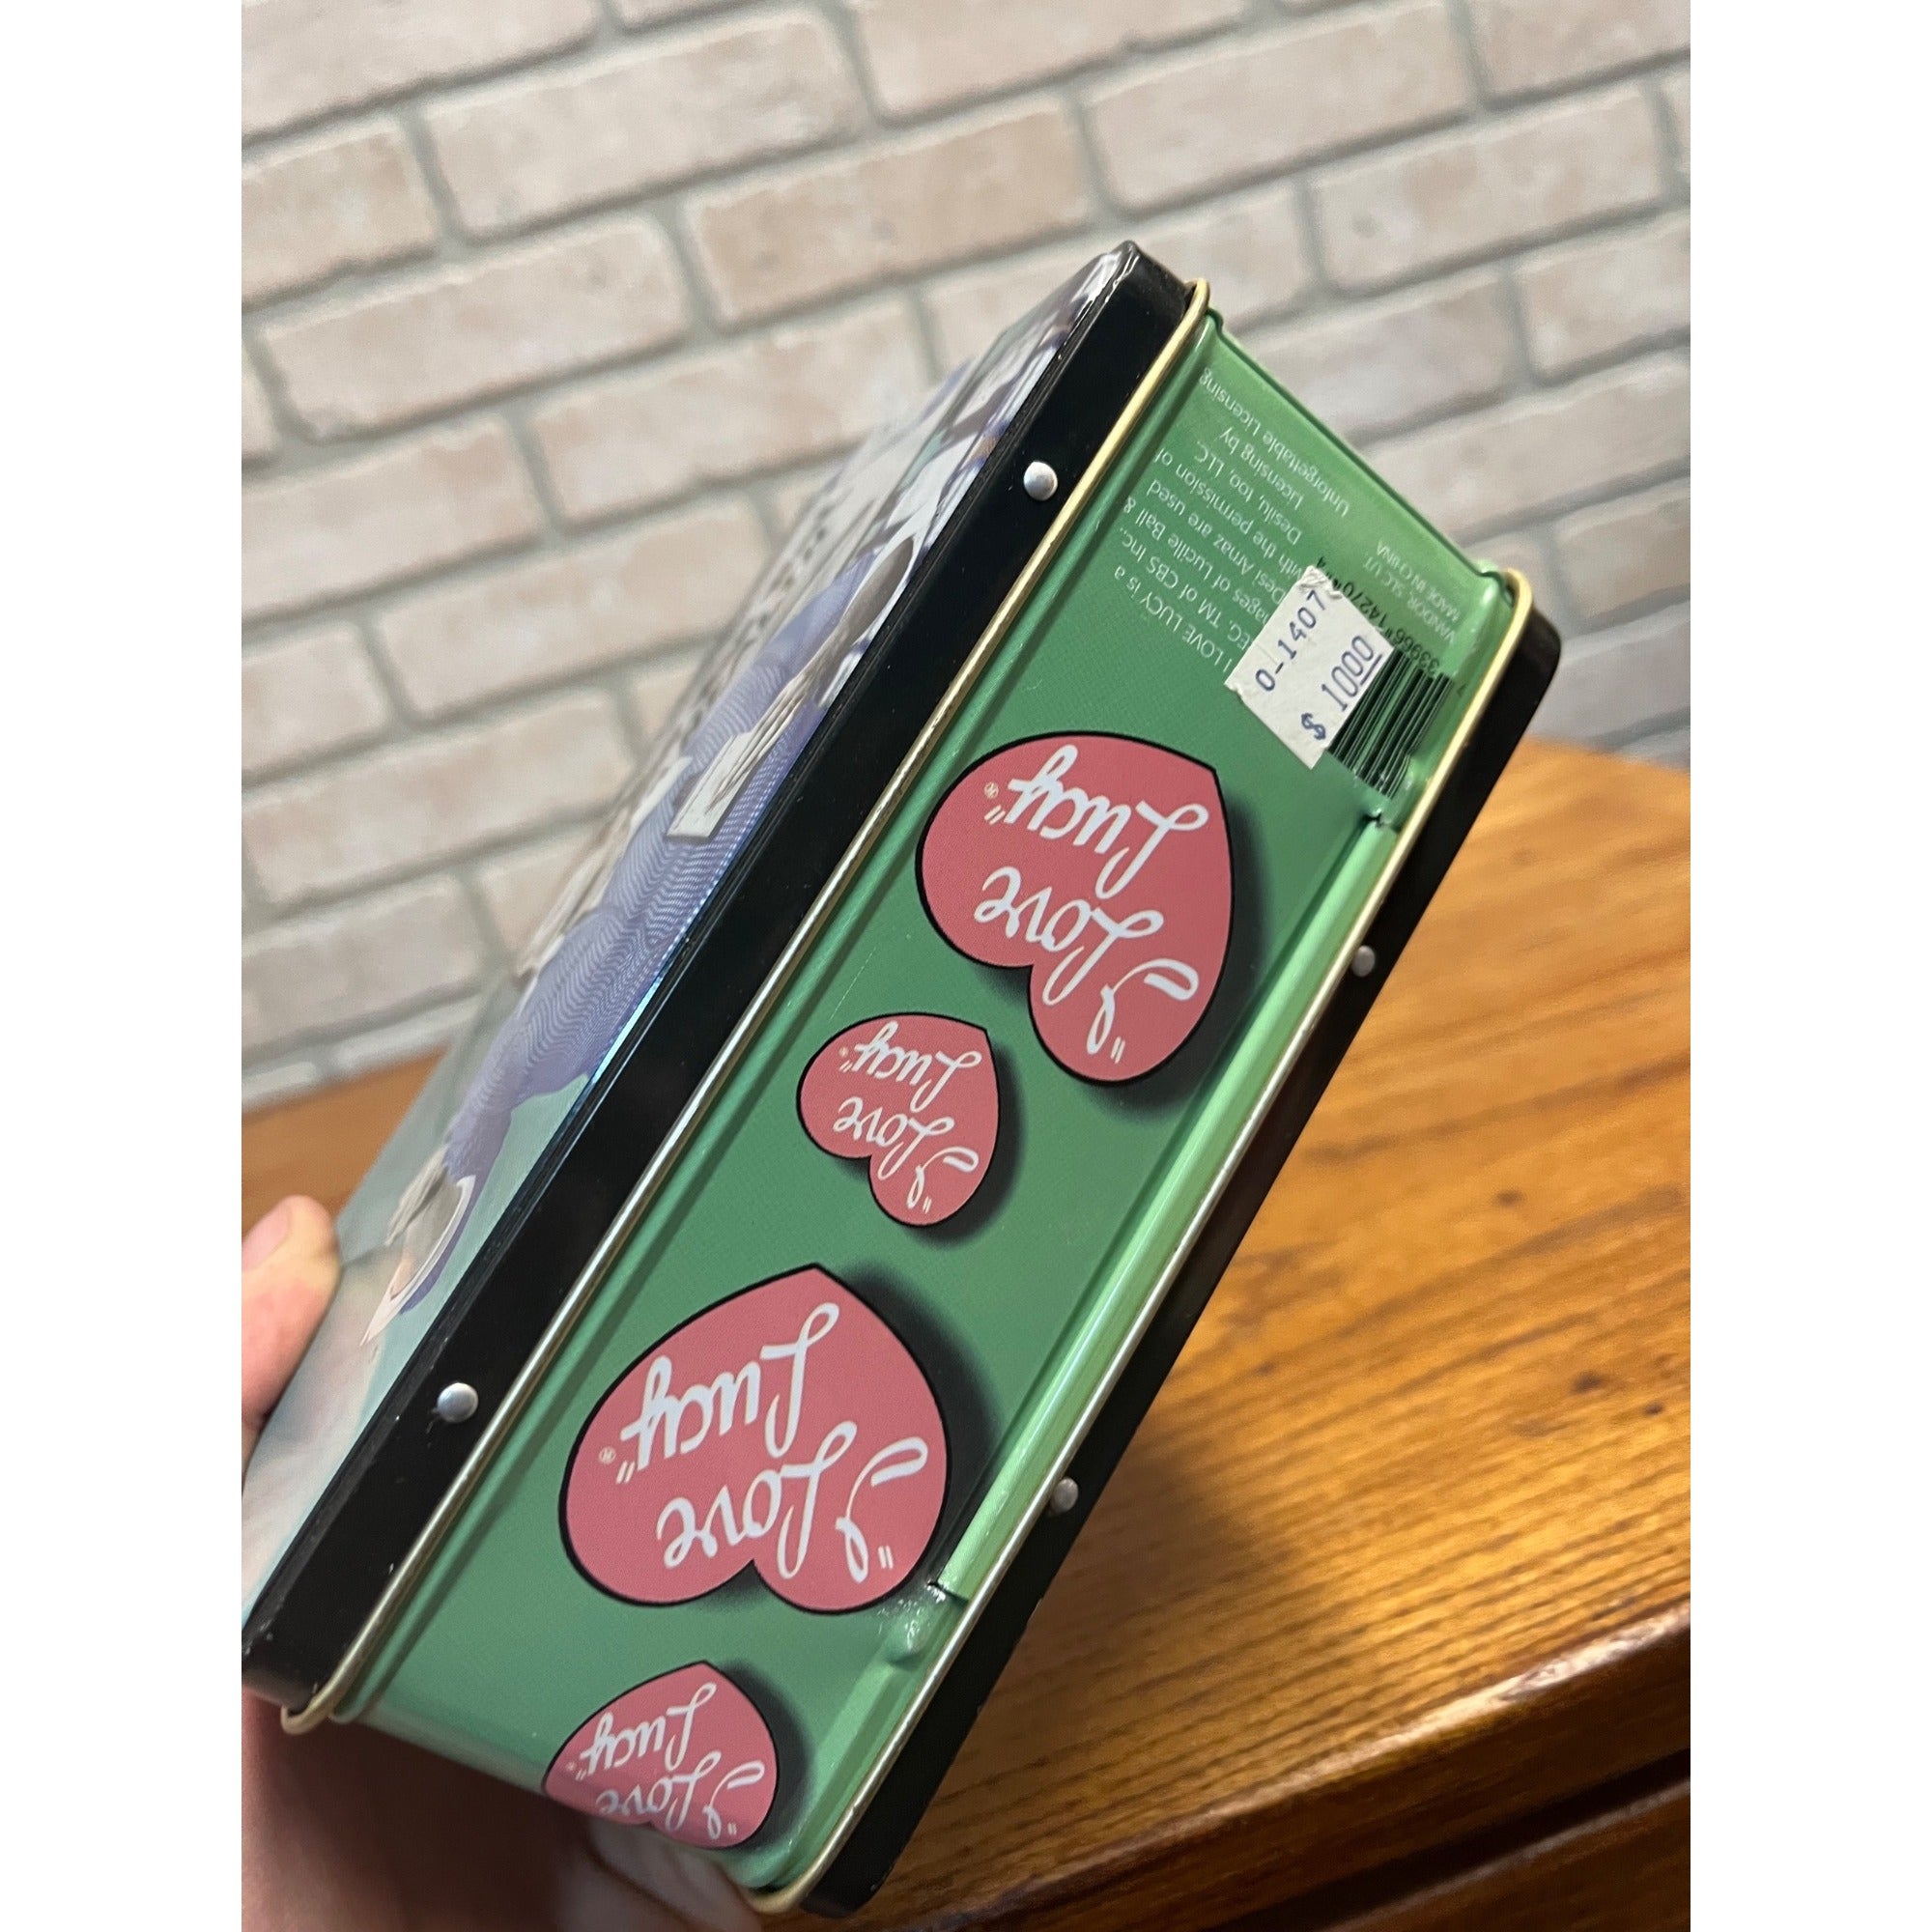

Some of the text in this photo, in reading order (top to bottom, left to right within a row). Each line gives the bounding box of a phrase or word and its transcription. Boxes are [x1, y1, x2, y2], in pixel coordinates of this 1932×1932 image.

[1152, 447, 1173, 466] of
[1199, 369, 1350, 518] Unforgettable Licensing
[1218, 426, 1304, 510] Licensing by
[1122, 496, 1136, 514] &
[1175, 463, 1254, 535] permission
[1190, 441, 1302, 545] Desilu, too, LLC.
[1134, 507, 1166, 541] Ball
[1146, 478, 1286, 605] Desi Arnaz are used
[1252, 530, 1276, 558] the
[1113, 565, 1125, 579] a
[1146, 555, 1179, 588] CBS
[1167, 533, 1213, 580] Lucille
[1125, 576, 1141, 598] is
[1178, 582, 1198, 602] of
[1210, 574, 1231, 591] of
[1376, 540, 1459, 621] MADE IN CHINA
[1139, 590, 1183, 632] LUCY
[1197, 598, 1221, 628] TM
[1181, 623, 1224, 666] LOVE
[1226, 619, 1250, 651] EG.
[974, 866, 1164, 1006] Love
[833, 1096, 954, 1179] Love
[656, 1420, 857, 1579] Love
[596, 1750, 721, 1832] Love
